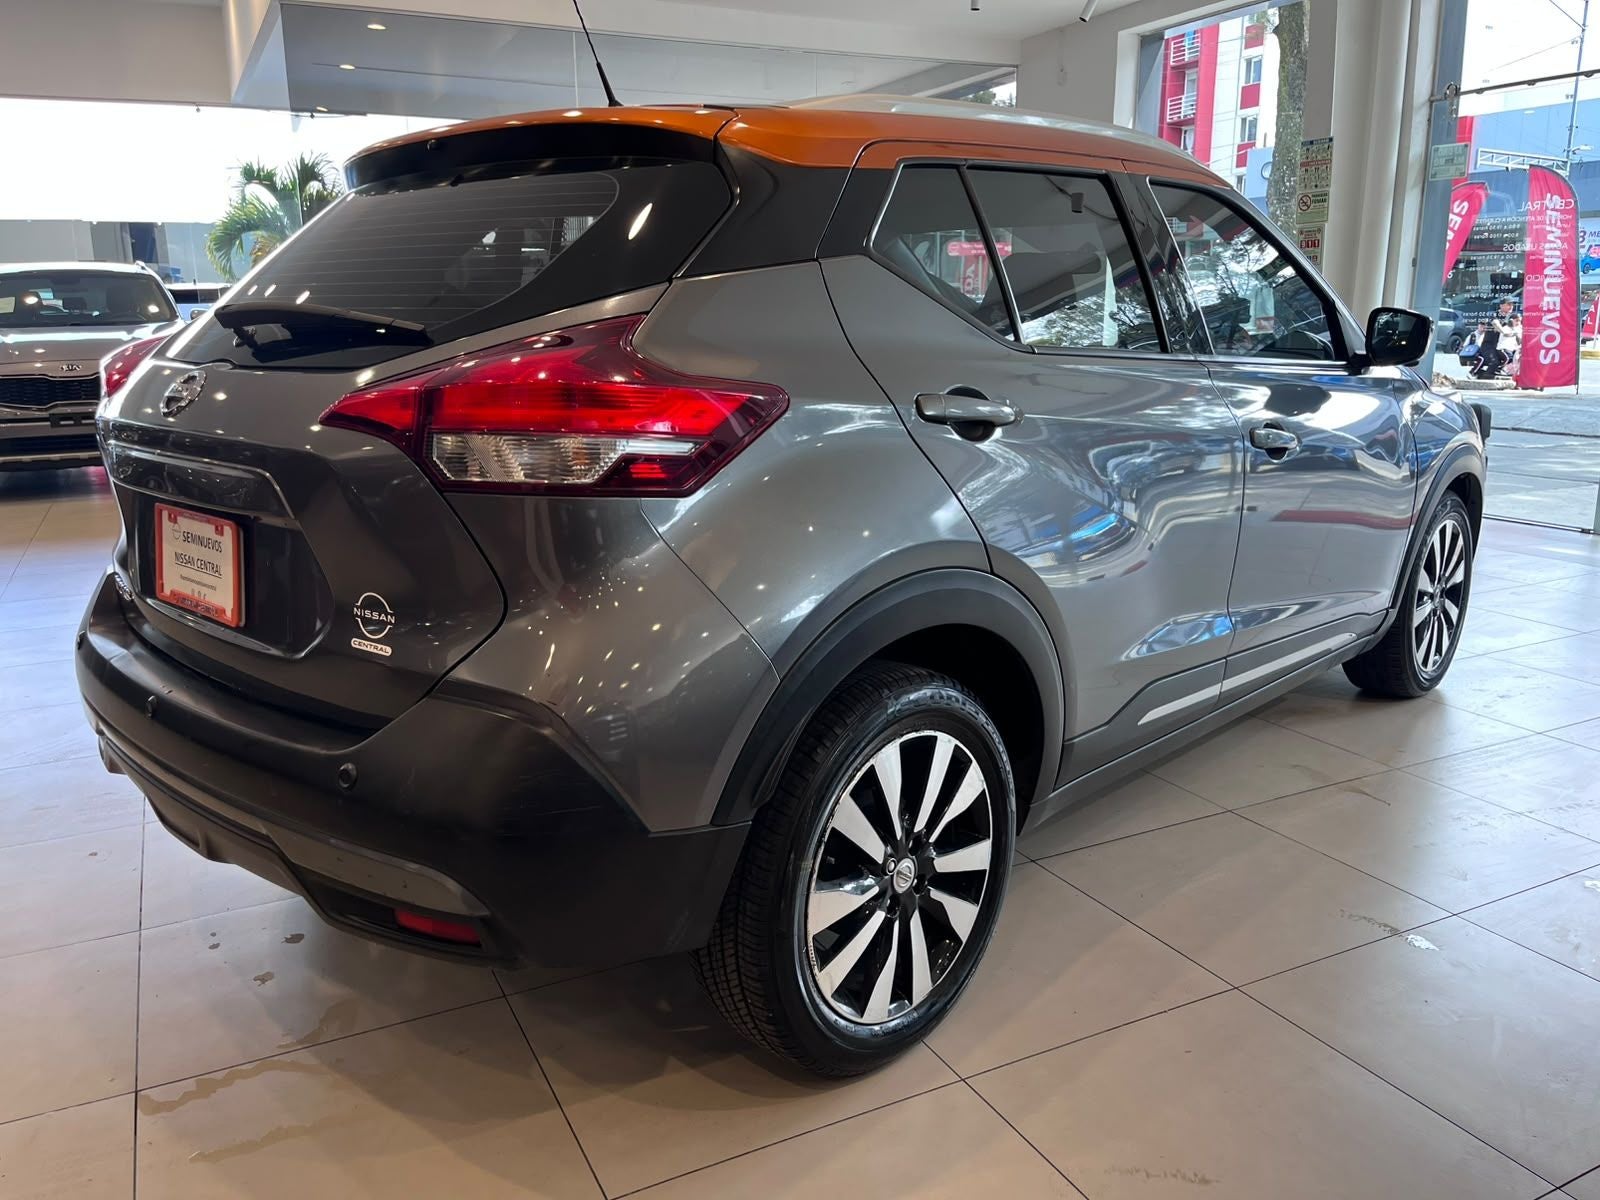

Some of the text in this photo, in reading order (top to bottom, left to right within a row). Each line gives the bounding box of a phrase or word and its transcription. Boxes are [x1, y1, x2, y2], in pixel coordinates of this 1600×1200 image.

[1301, 239, 1319, 248] 911
[1540, 192, 1562, 365] SEMINUEVOS
[182, 530, 222, 553] SEMINUEVOS
[175, 552, 222, 576] NISSAN CENTRAL
[353, 607, 395, 623] NISSAN
[353, 640, 390, 654] CENTRAL
